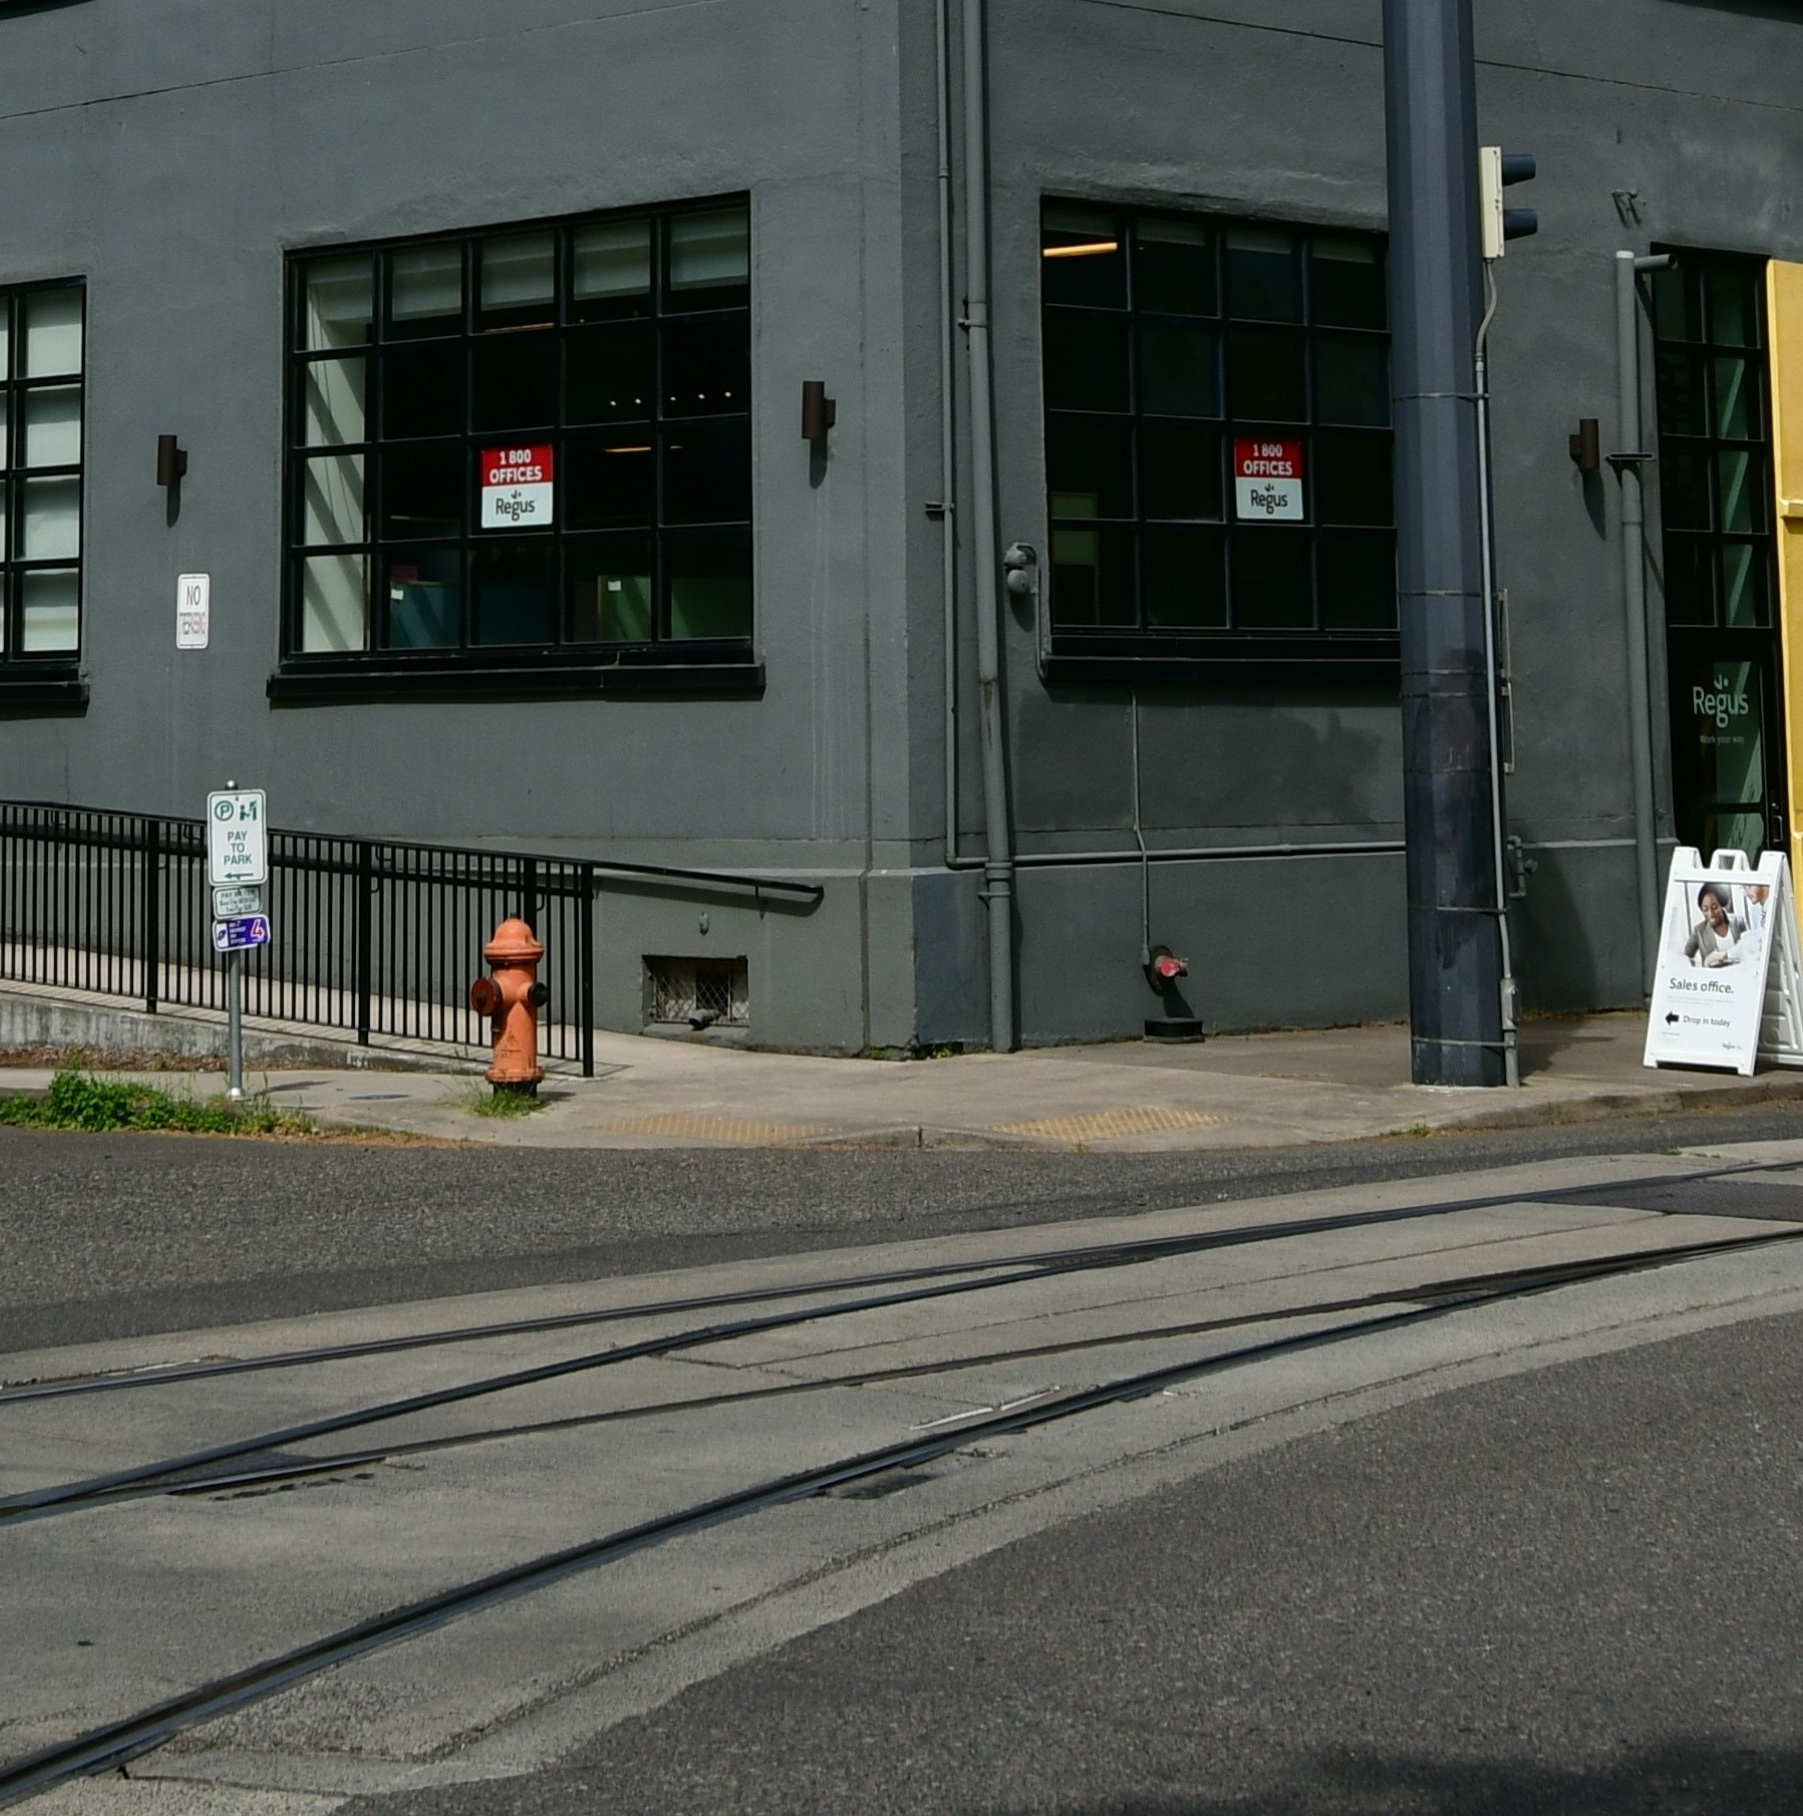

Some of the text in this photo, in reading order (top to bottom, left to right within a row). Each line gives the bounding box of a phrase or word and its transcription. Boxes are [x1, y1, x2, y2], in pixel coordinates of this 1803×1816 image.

[499, 448, 532, 465] 1 800
[1261, 443, 1284, 458] 800
[488, 465, 543, 484] OFFICES
[1242, 459, 1294, 476] OFFICES
[495, 497, 536, 522] Regus
[1250, 488, 1289, 515] Regus
[186, 585, 202, 606] NO
[1692, 685, 1750, 729] Regus
[227, 830, 248, 842] PAY
[230, 842, 246, 853] TO
[223, 854, 253, 866] PARK
[1669, 977, 1734, 994] Sales office.
[1683, 1015, 1732, 1028] Drop in today
